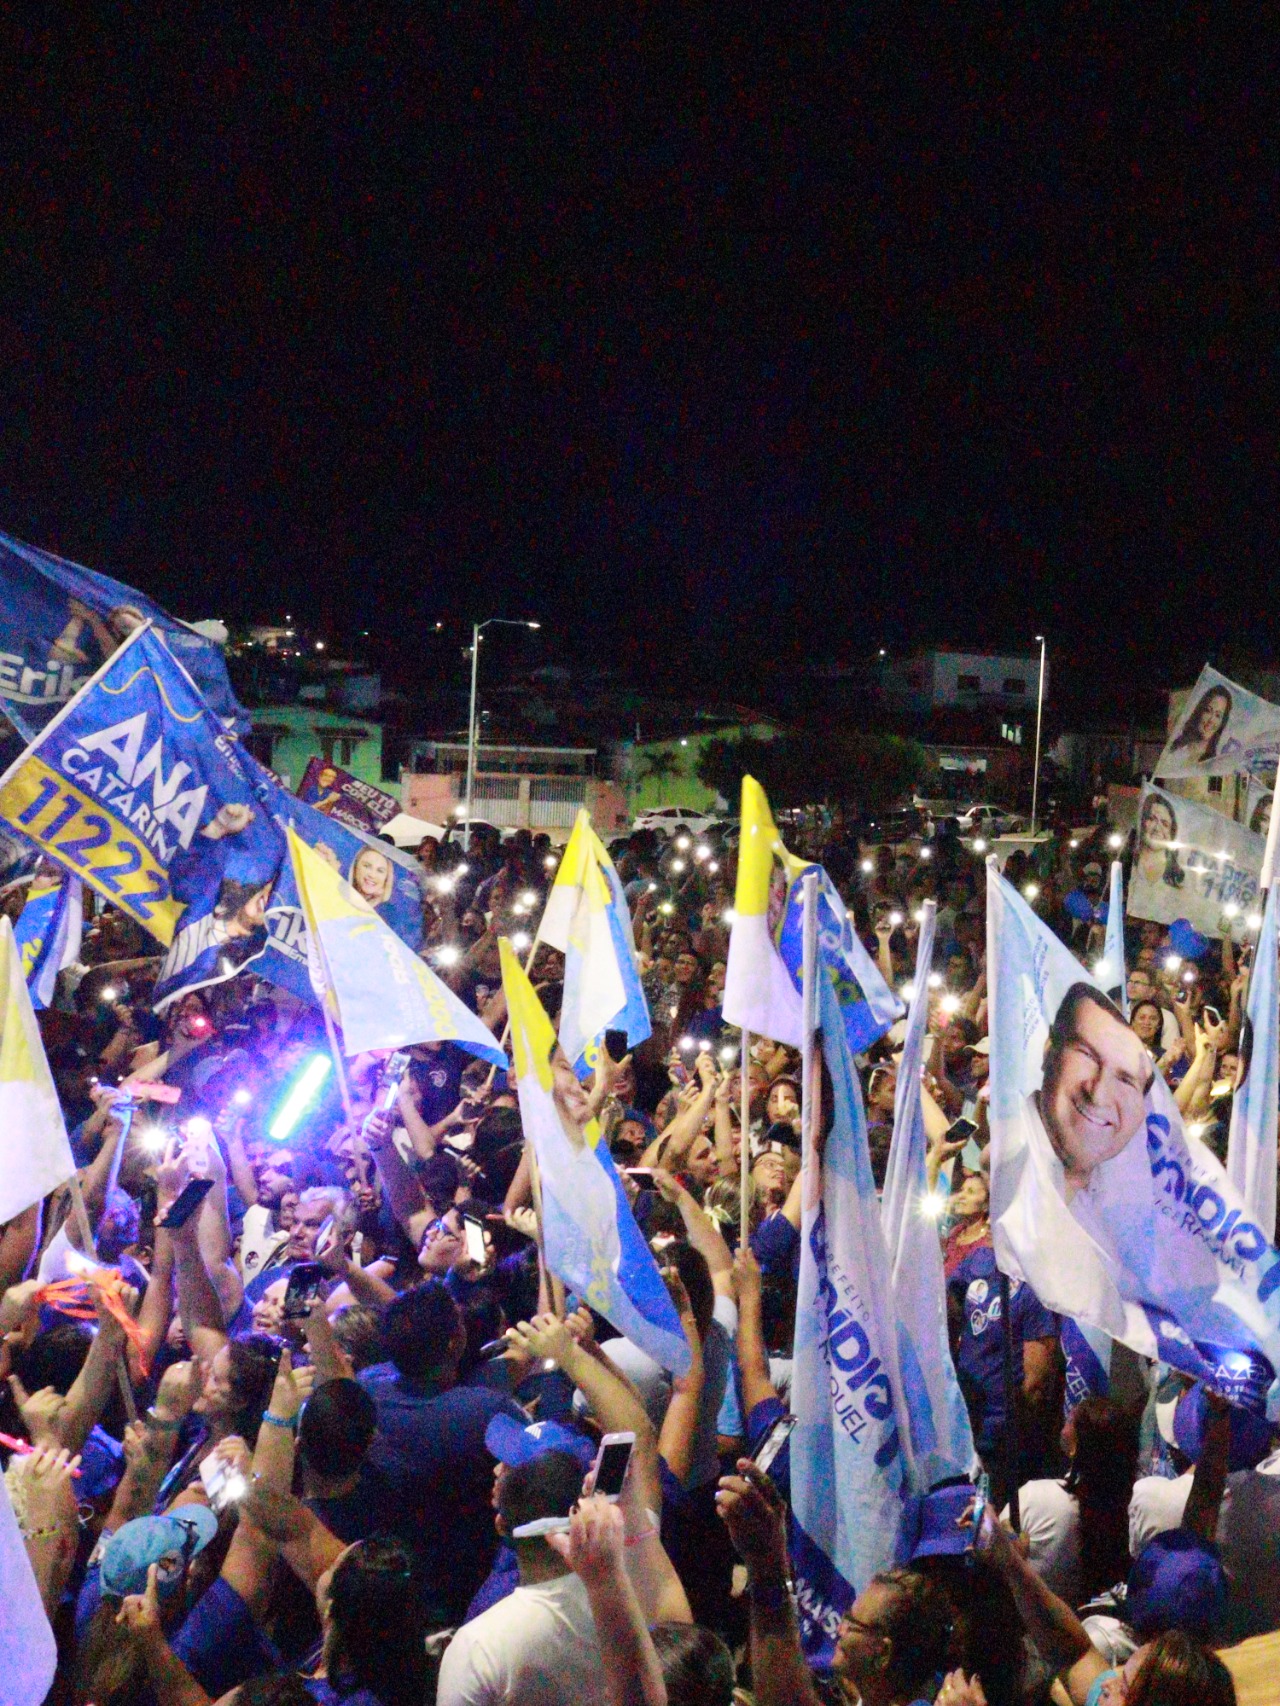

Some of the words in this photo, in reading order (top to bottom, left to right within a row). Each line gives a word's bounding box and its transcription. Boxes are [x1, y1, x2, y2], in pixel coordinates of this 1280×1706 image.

[17, 777, 171, 919] 11222
[61, 748, 177, 866] CATARIN
[78, 711, 209, 850] ANA
